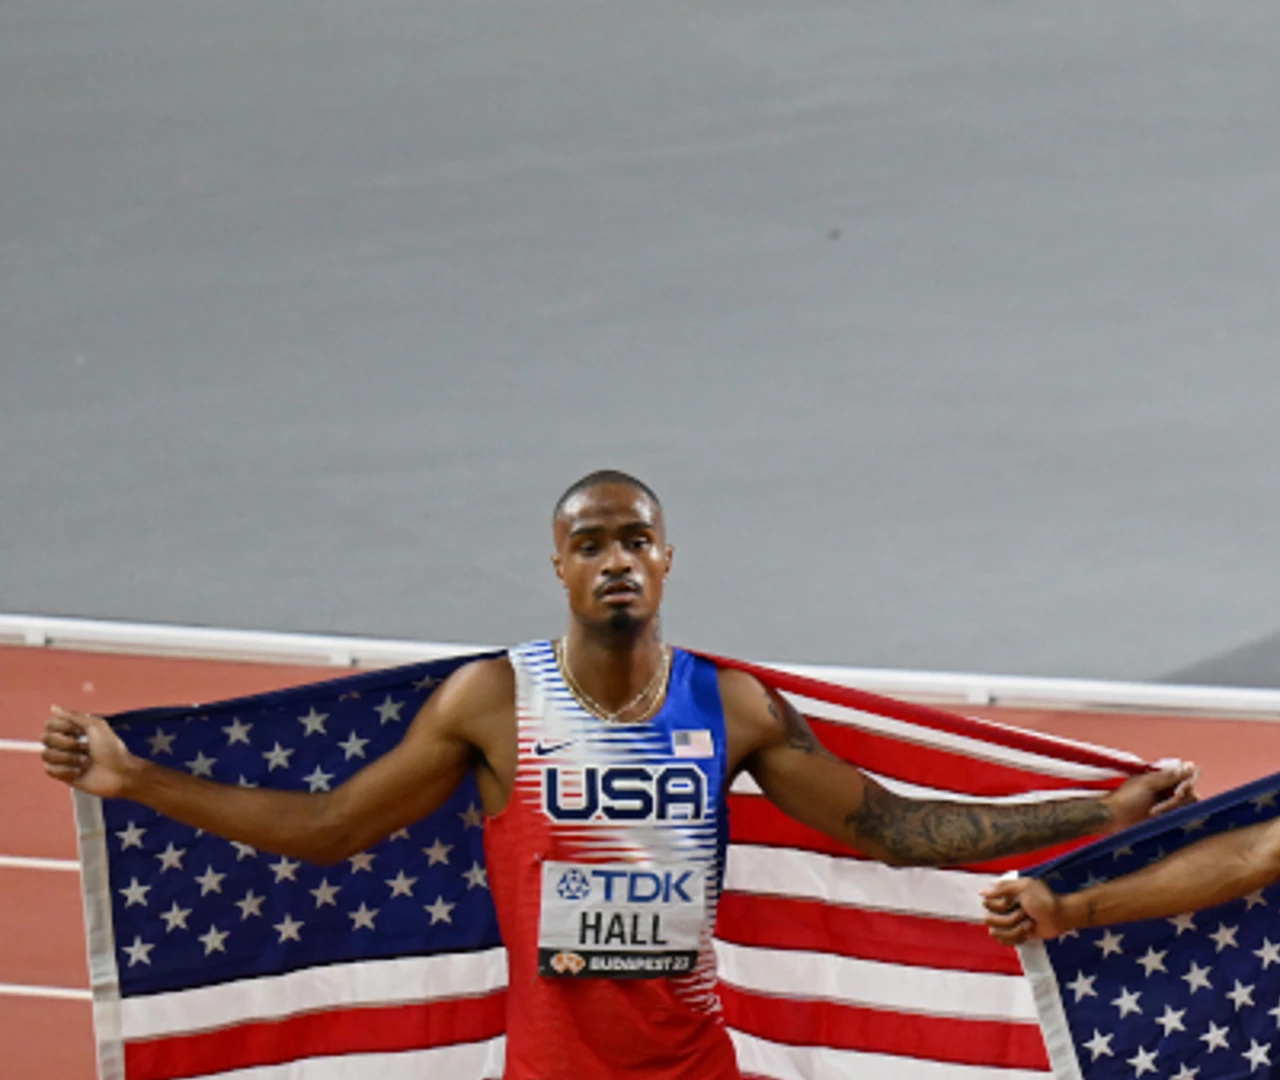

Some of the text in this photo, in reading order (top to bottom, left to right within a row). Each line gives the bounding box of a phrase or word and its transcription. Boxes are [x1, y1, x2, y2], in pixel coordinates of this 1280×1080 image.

[545, 767, 705, 820] USA
[591, 869, 693, 903] TDK
[578, 911, 668, 945] HALL
